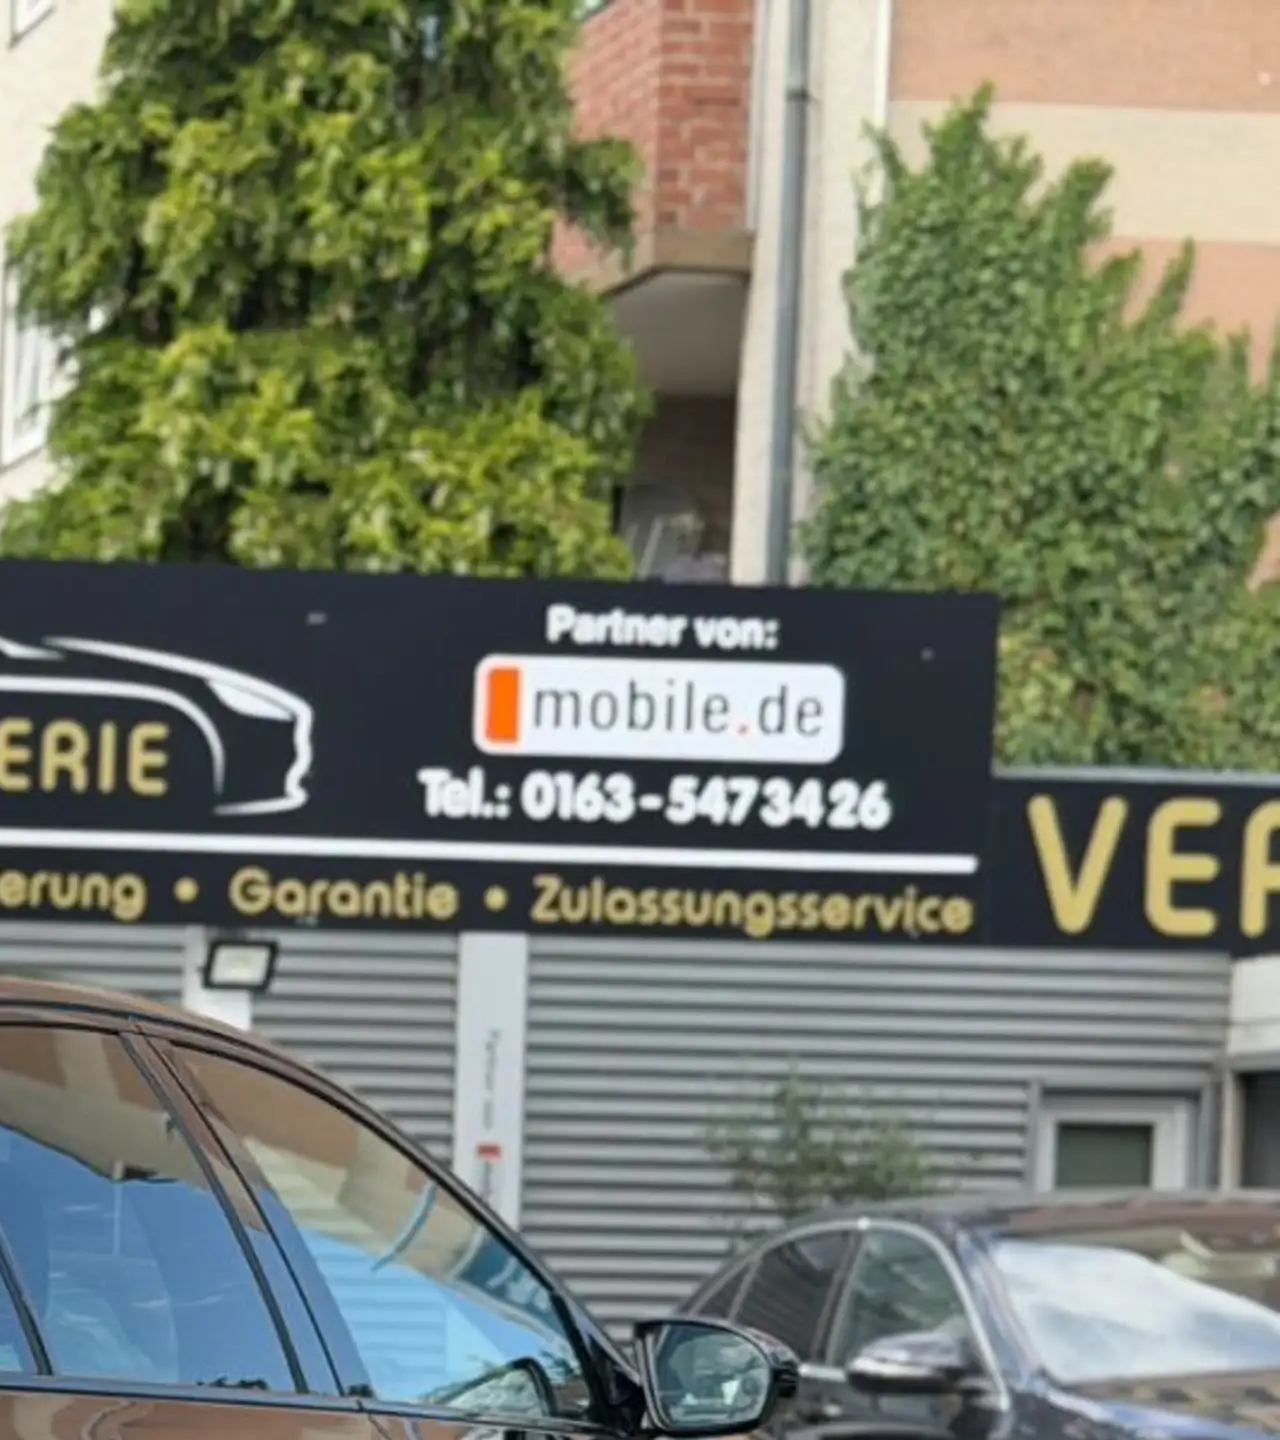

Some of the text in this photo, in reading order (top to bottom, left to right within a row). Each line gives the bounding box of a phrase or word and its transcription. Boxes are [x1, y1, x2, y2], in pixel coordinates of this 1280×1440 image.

[545, 603, 780, 651] Partner von:
[532, 677, 826, 738] mobile.de
[416, 766, 511, 819] Tel.:
[229, 867, 458, 917] Garantie
[530, 874, 974, 937] Zulassungsservice
